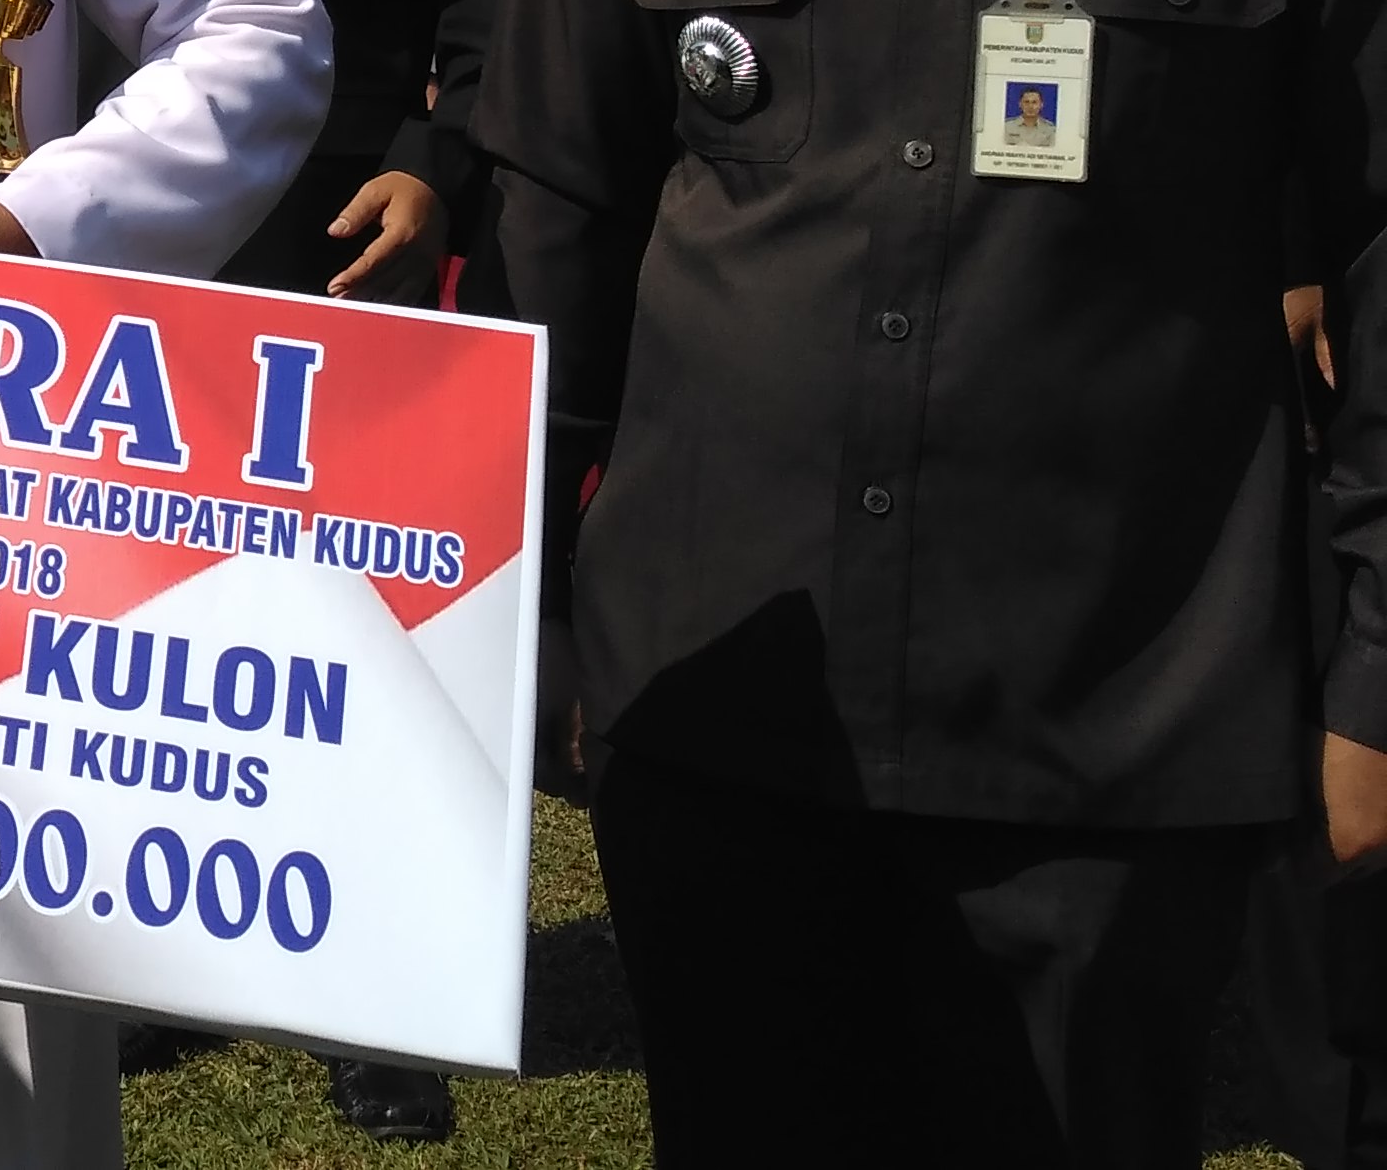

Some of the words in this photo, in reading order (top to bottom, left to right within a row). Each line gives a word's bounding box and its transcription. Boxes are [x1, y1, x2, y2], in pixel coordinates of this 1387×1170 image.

[248, 341, 318, 485] I
[48, 476, 300, 560] KABUPATEN
[313, 517, 463, 585] KUDUS
[25, 614, 348, 746] KULON
[70, 728, 270, 809] KUDUS
